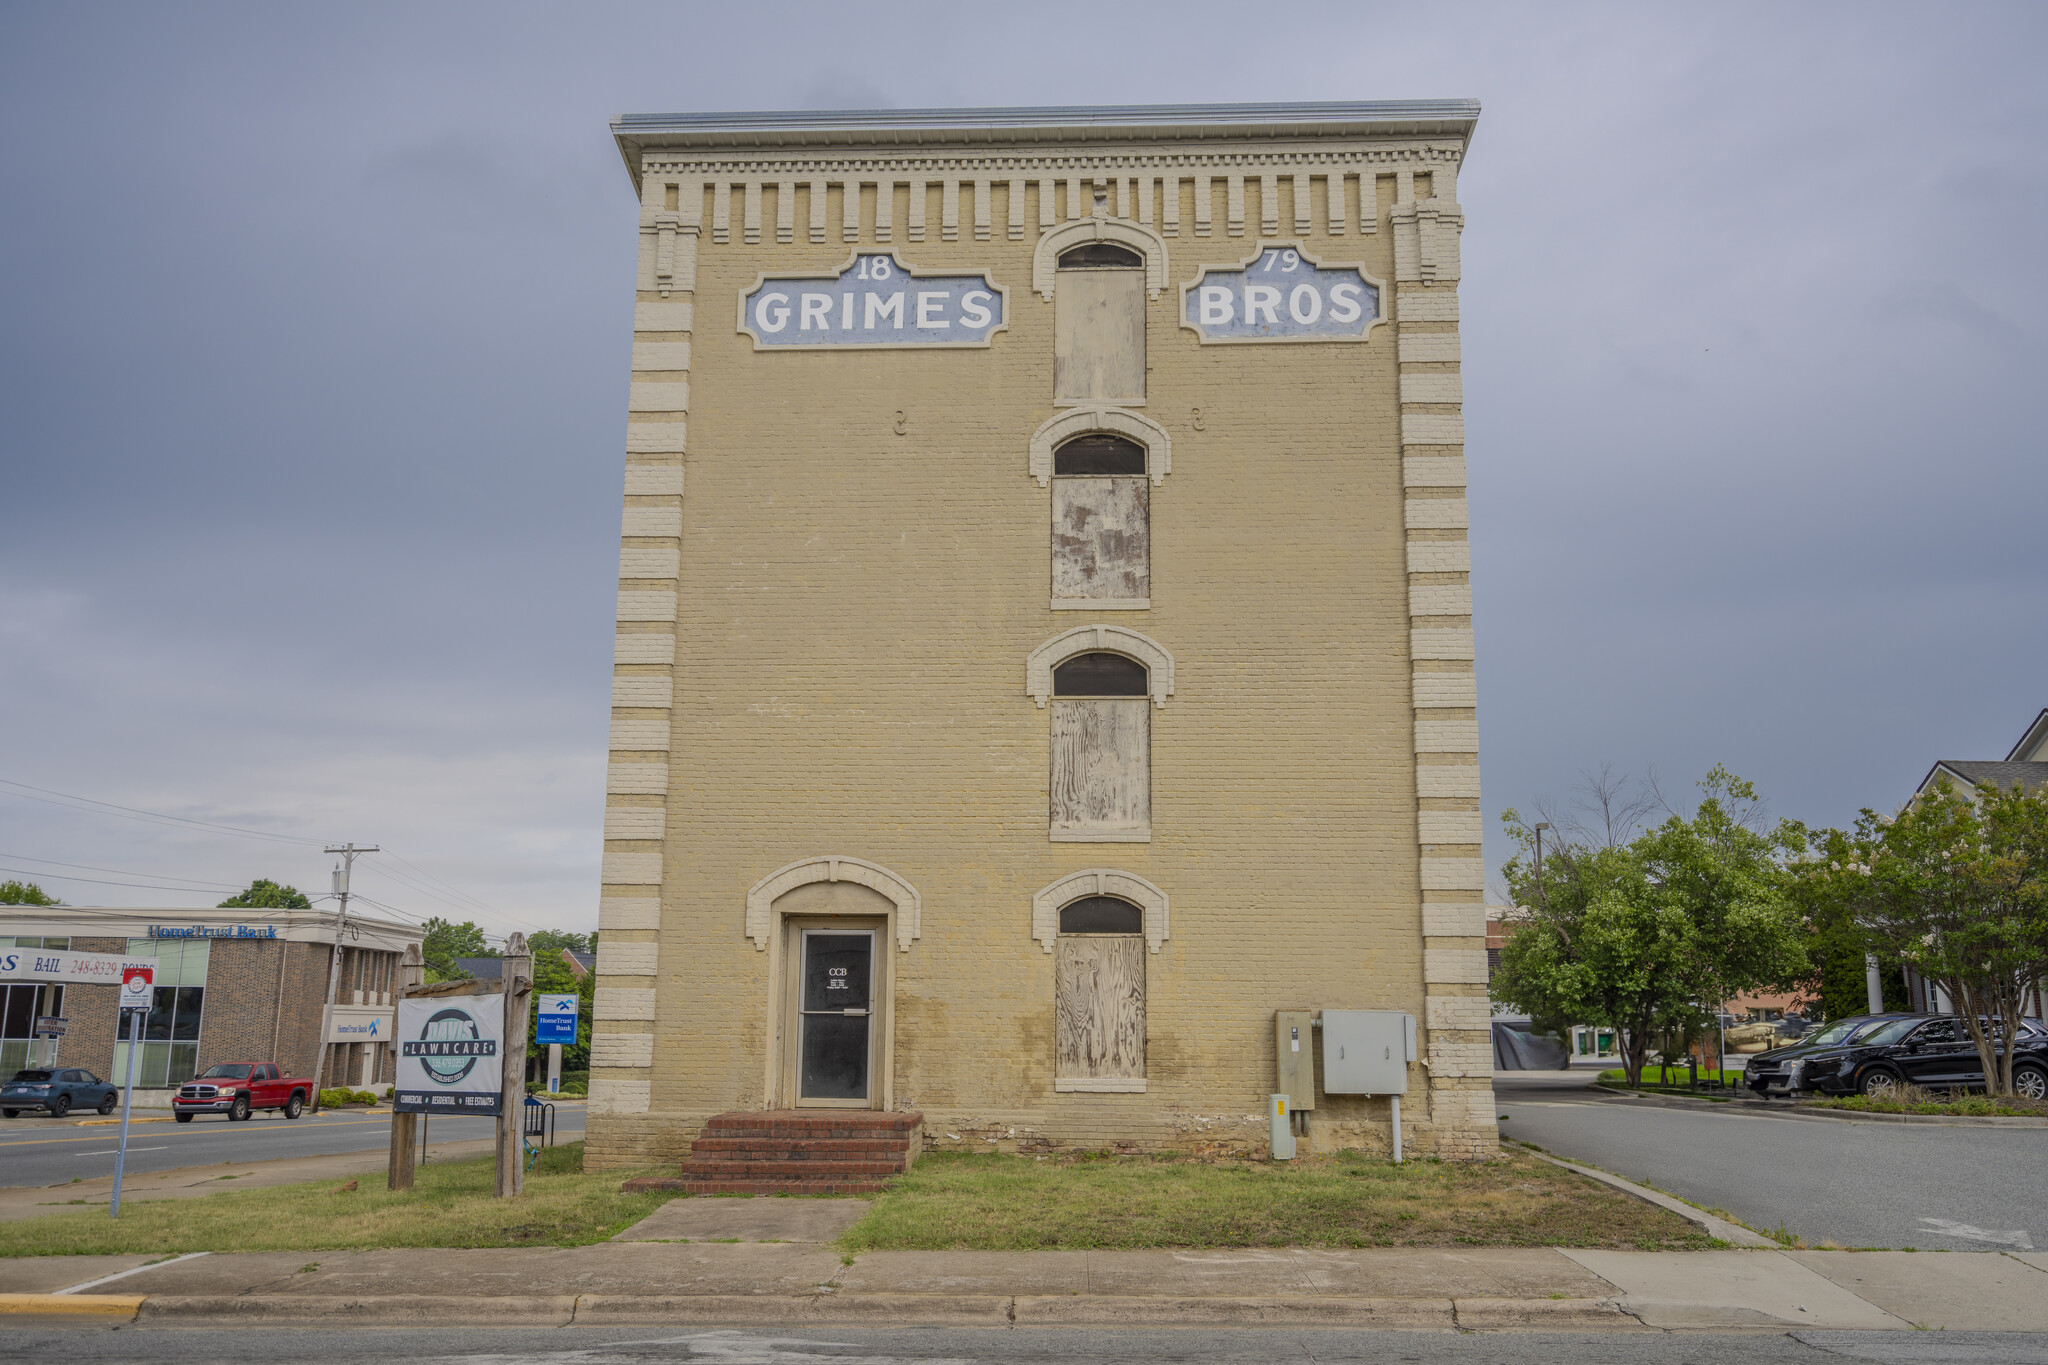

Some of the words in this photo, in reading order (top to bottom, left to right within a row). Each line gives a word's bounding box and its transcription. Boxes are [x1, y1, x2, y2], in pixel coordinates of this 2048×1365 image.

[858, 255, 891, 281] 18
[1263, 249, 1300, 273] 79
[755, 290, 993, 333] GRIMES
[1200, 283, 1363, 325] BROS
[147, 924, 234, 938] HomeTrust
[237, 925, 277, 938] Bank
[33, 957, 61, 973] BAIL
[70, 959, 117, 976] 248-8329
[426, 1020, 474, 1040] DAVIS
[431, 1070, 453, 1082] ESTABLISHED
[400, 1094, 423, 1104] COMMERCIAL
[431, 1095, 456, 1105] RESIDENTIAL
[465, 1096, 474, 1106] FREE
[475, 1096, 495, 1106] ESTIMATES
